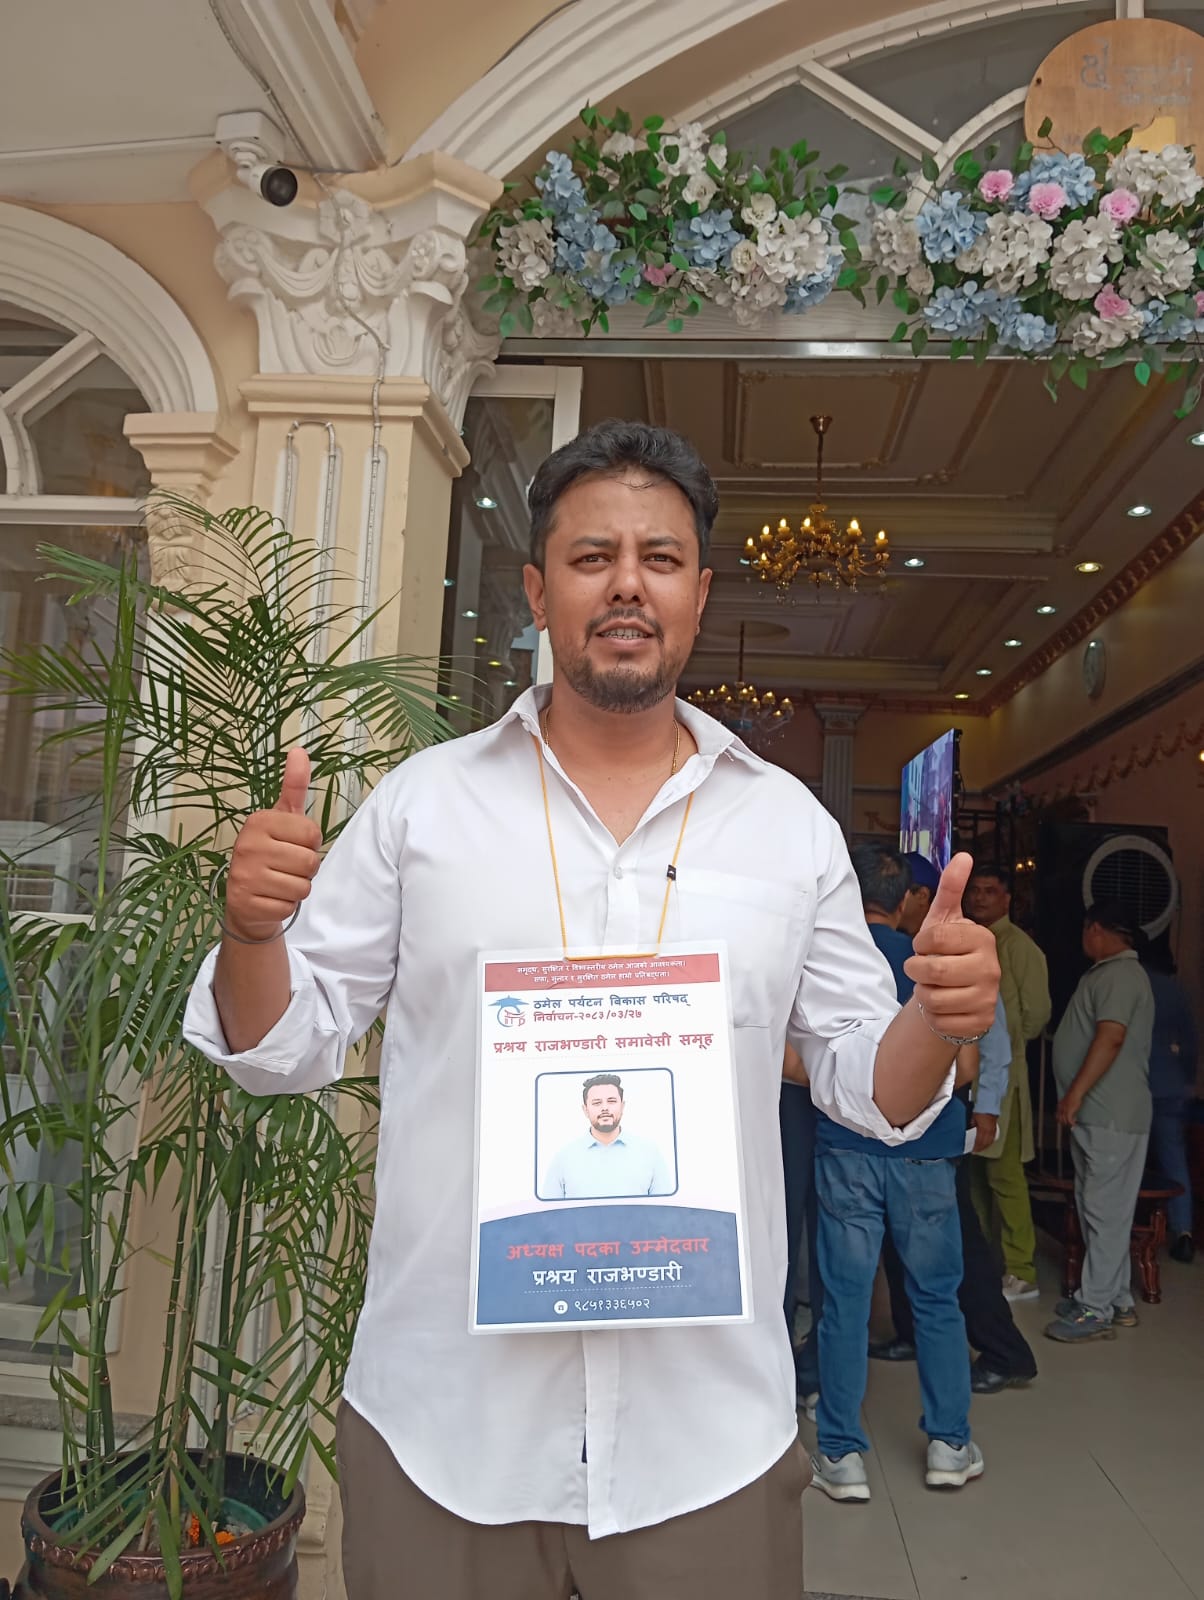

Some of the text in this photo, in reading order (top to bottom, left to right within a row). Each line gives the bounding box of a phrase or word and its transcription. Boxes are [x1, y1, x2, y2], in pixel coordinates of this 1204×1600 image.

[534, 992, 690, 1009] ठमेल पर्यटन विकास परिषद्
[494, 1032, 713, 1053] प्रश्रय राजभण्डारी समावेसी समूह
[506, 1236, 709, 1260] अध्यक्ष पदका उम्मेदवार
[533, 1261, 683, 1286] प्रश्रय राजभण्डारी
